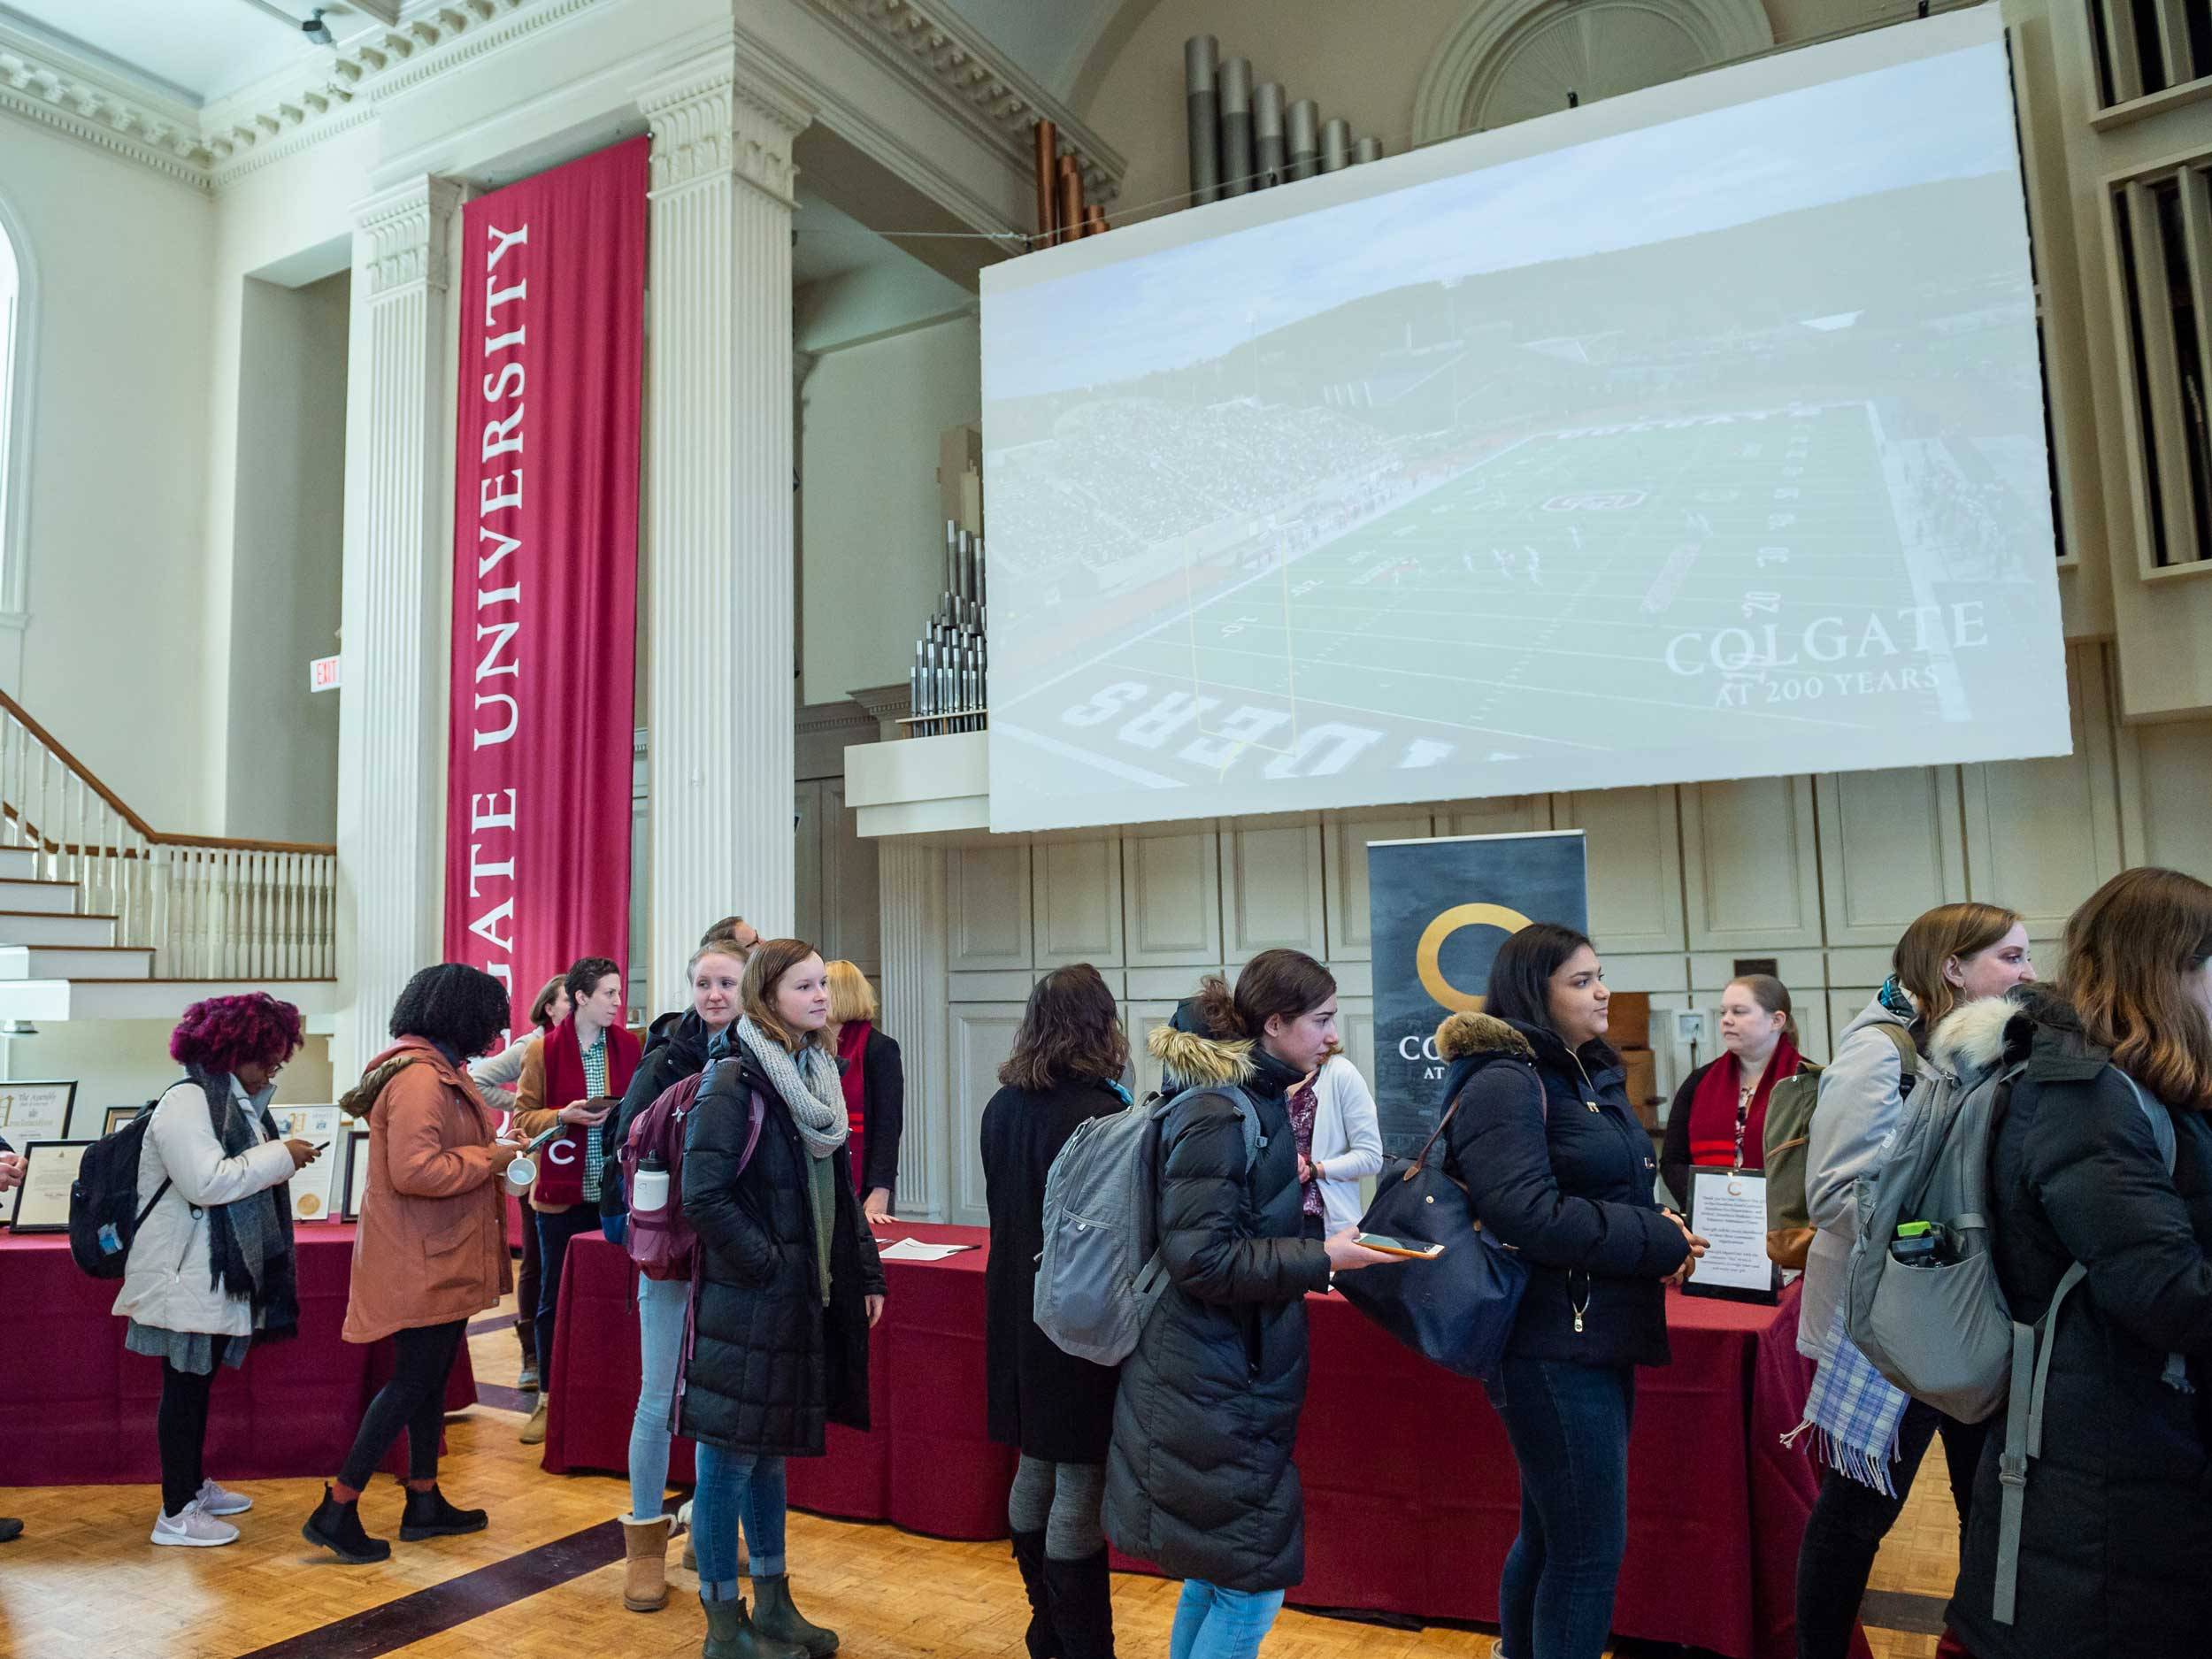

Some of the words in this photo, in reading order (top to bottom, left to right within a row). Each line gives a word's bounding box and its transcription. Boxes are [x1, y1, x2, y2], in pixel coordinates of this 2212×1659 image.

[472, 223, 529, 751] UNIVERSITY
[1664, 600, 1988, 676] COLGATE
[1715, 682, 1755, 708] AT
[1764, 676, 1824, 703] 200
[1832, 664, 1939, 697] YEARS
[1423, 1066, 1446, 1079] AT
[548, 1139, 577, 1165] C
